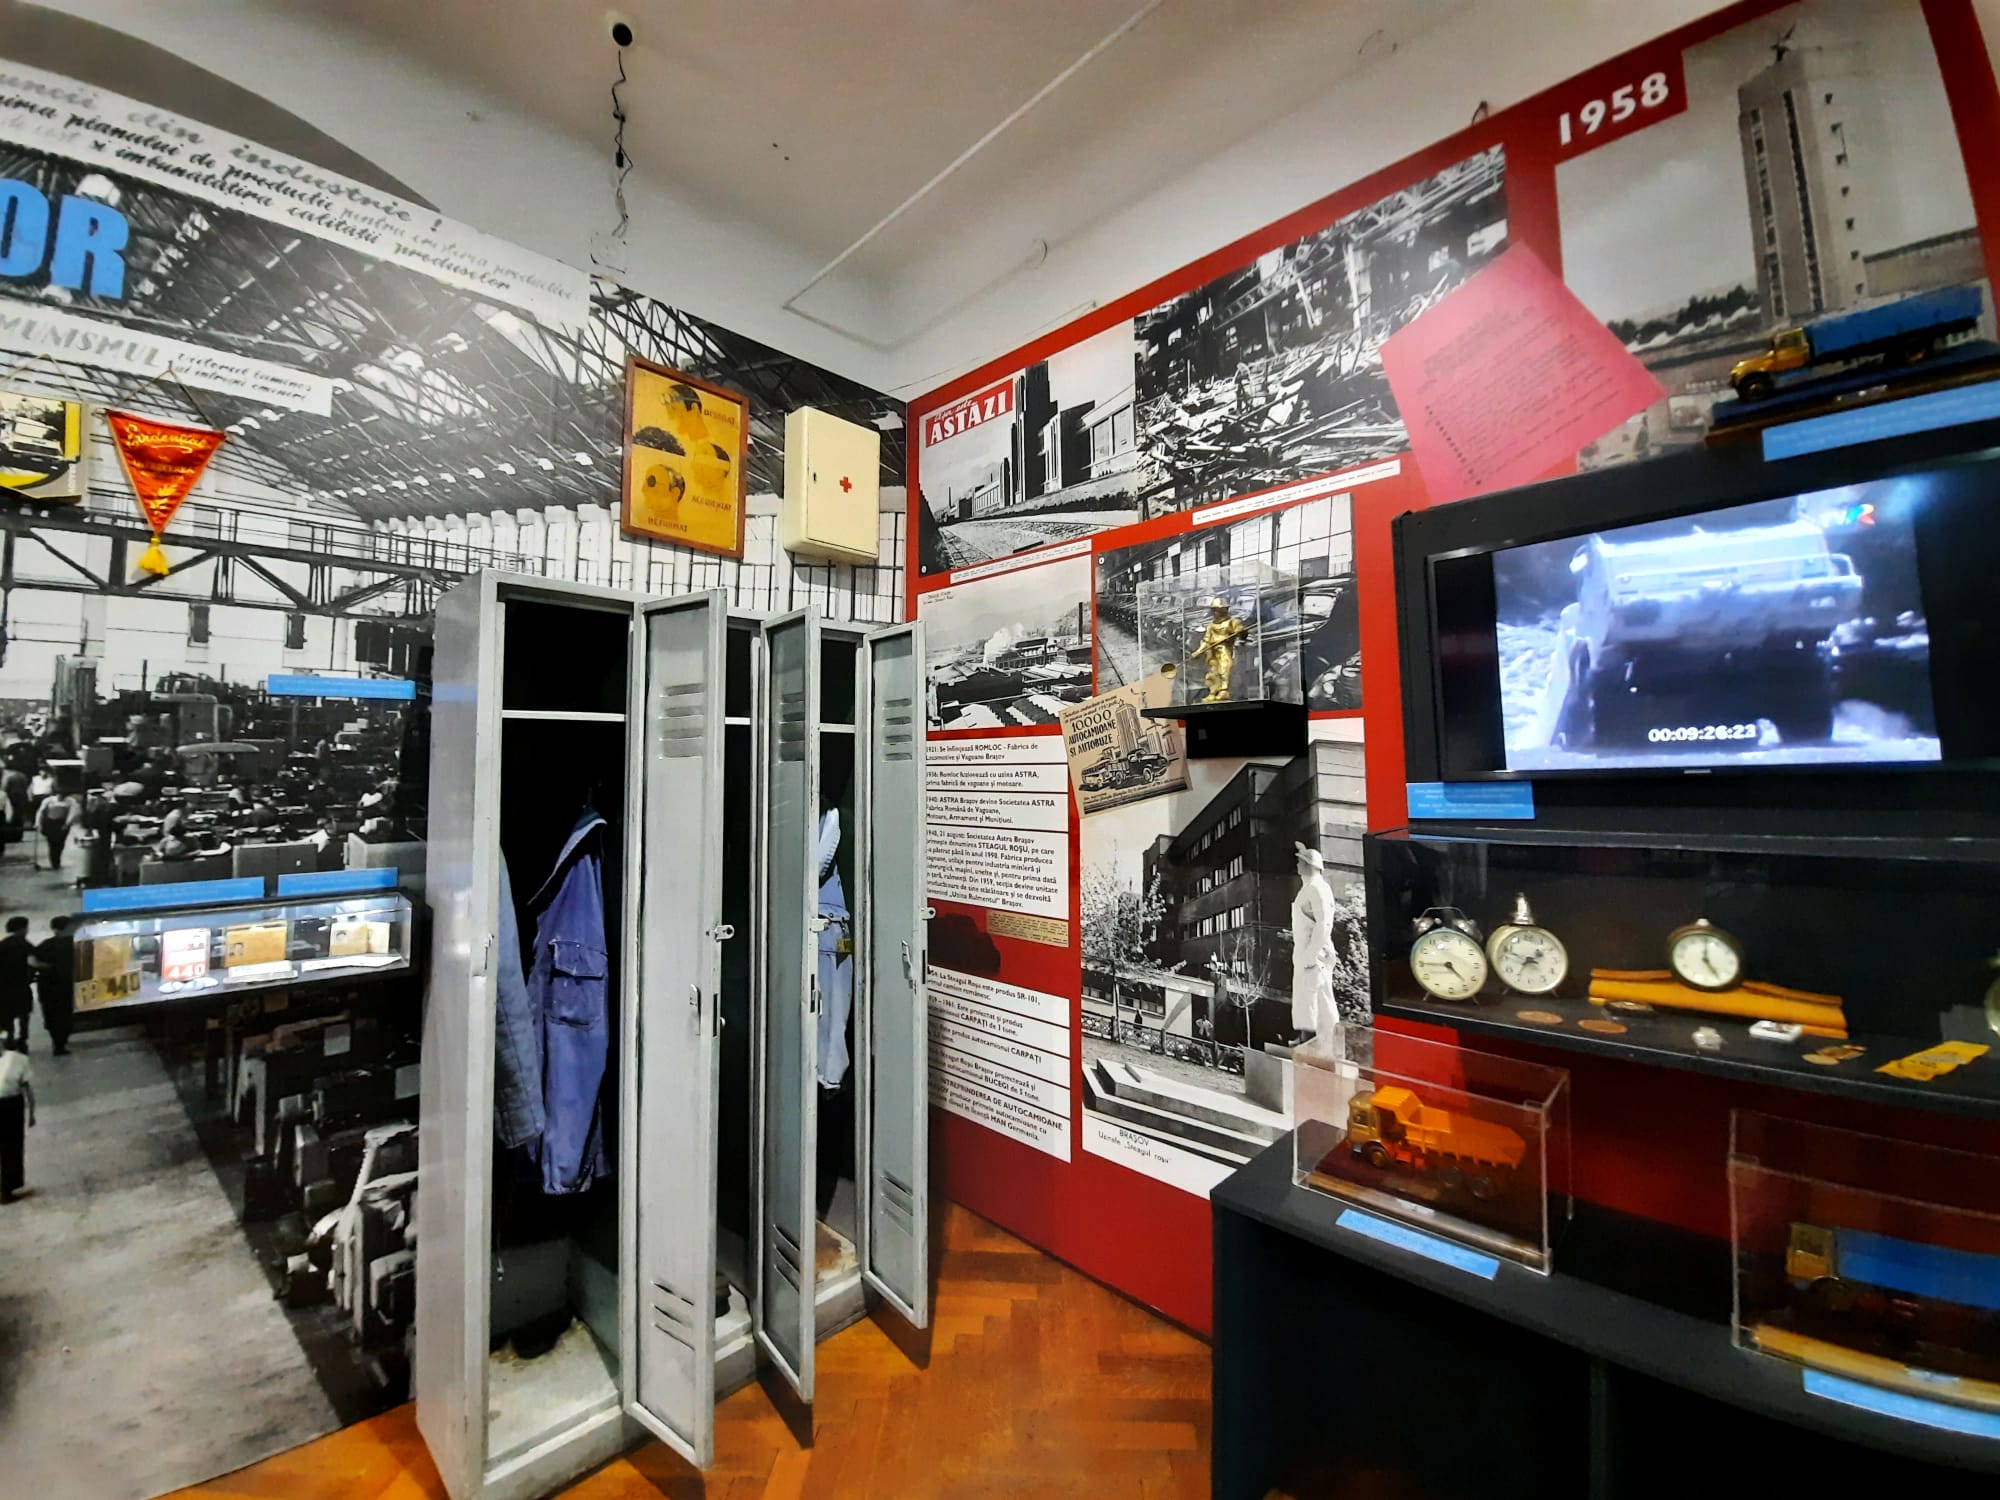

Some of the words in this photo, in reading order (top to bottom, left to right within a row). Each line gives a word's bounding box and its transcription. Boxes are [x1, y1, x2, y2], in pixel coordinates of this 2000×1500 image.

[1559, 72, 1669, 146] 1958
[230, 143, 410, 222] industrie
[1071, 709, 1112, 733] 10000
[1078, 734, 1113, 754] AUTOBUZE
[1015, 771, 1040, 779] ASTRA,
[978, 842, 1008, 851] STEAGUL
[1001, 852, 1022, 861] Fabrica
